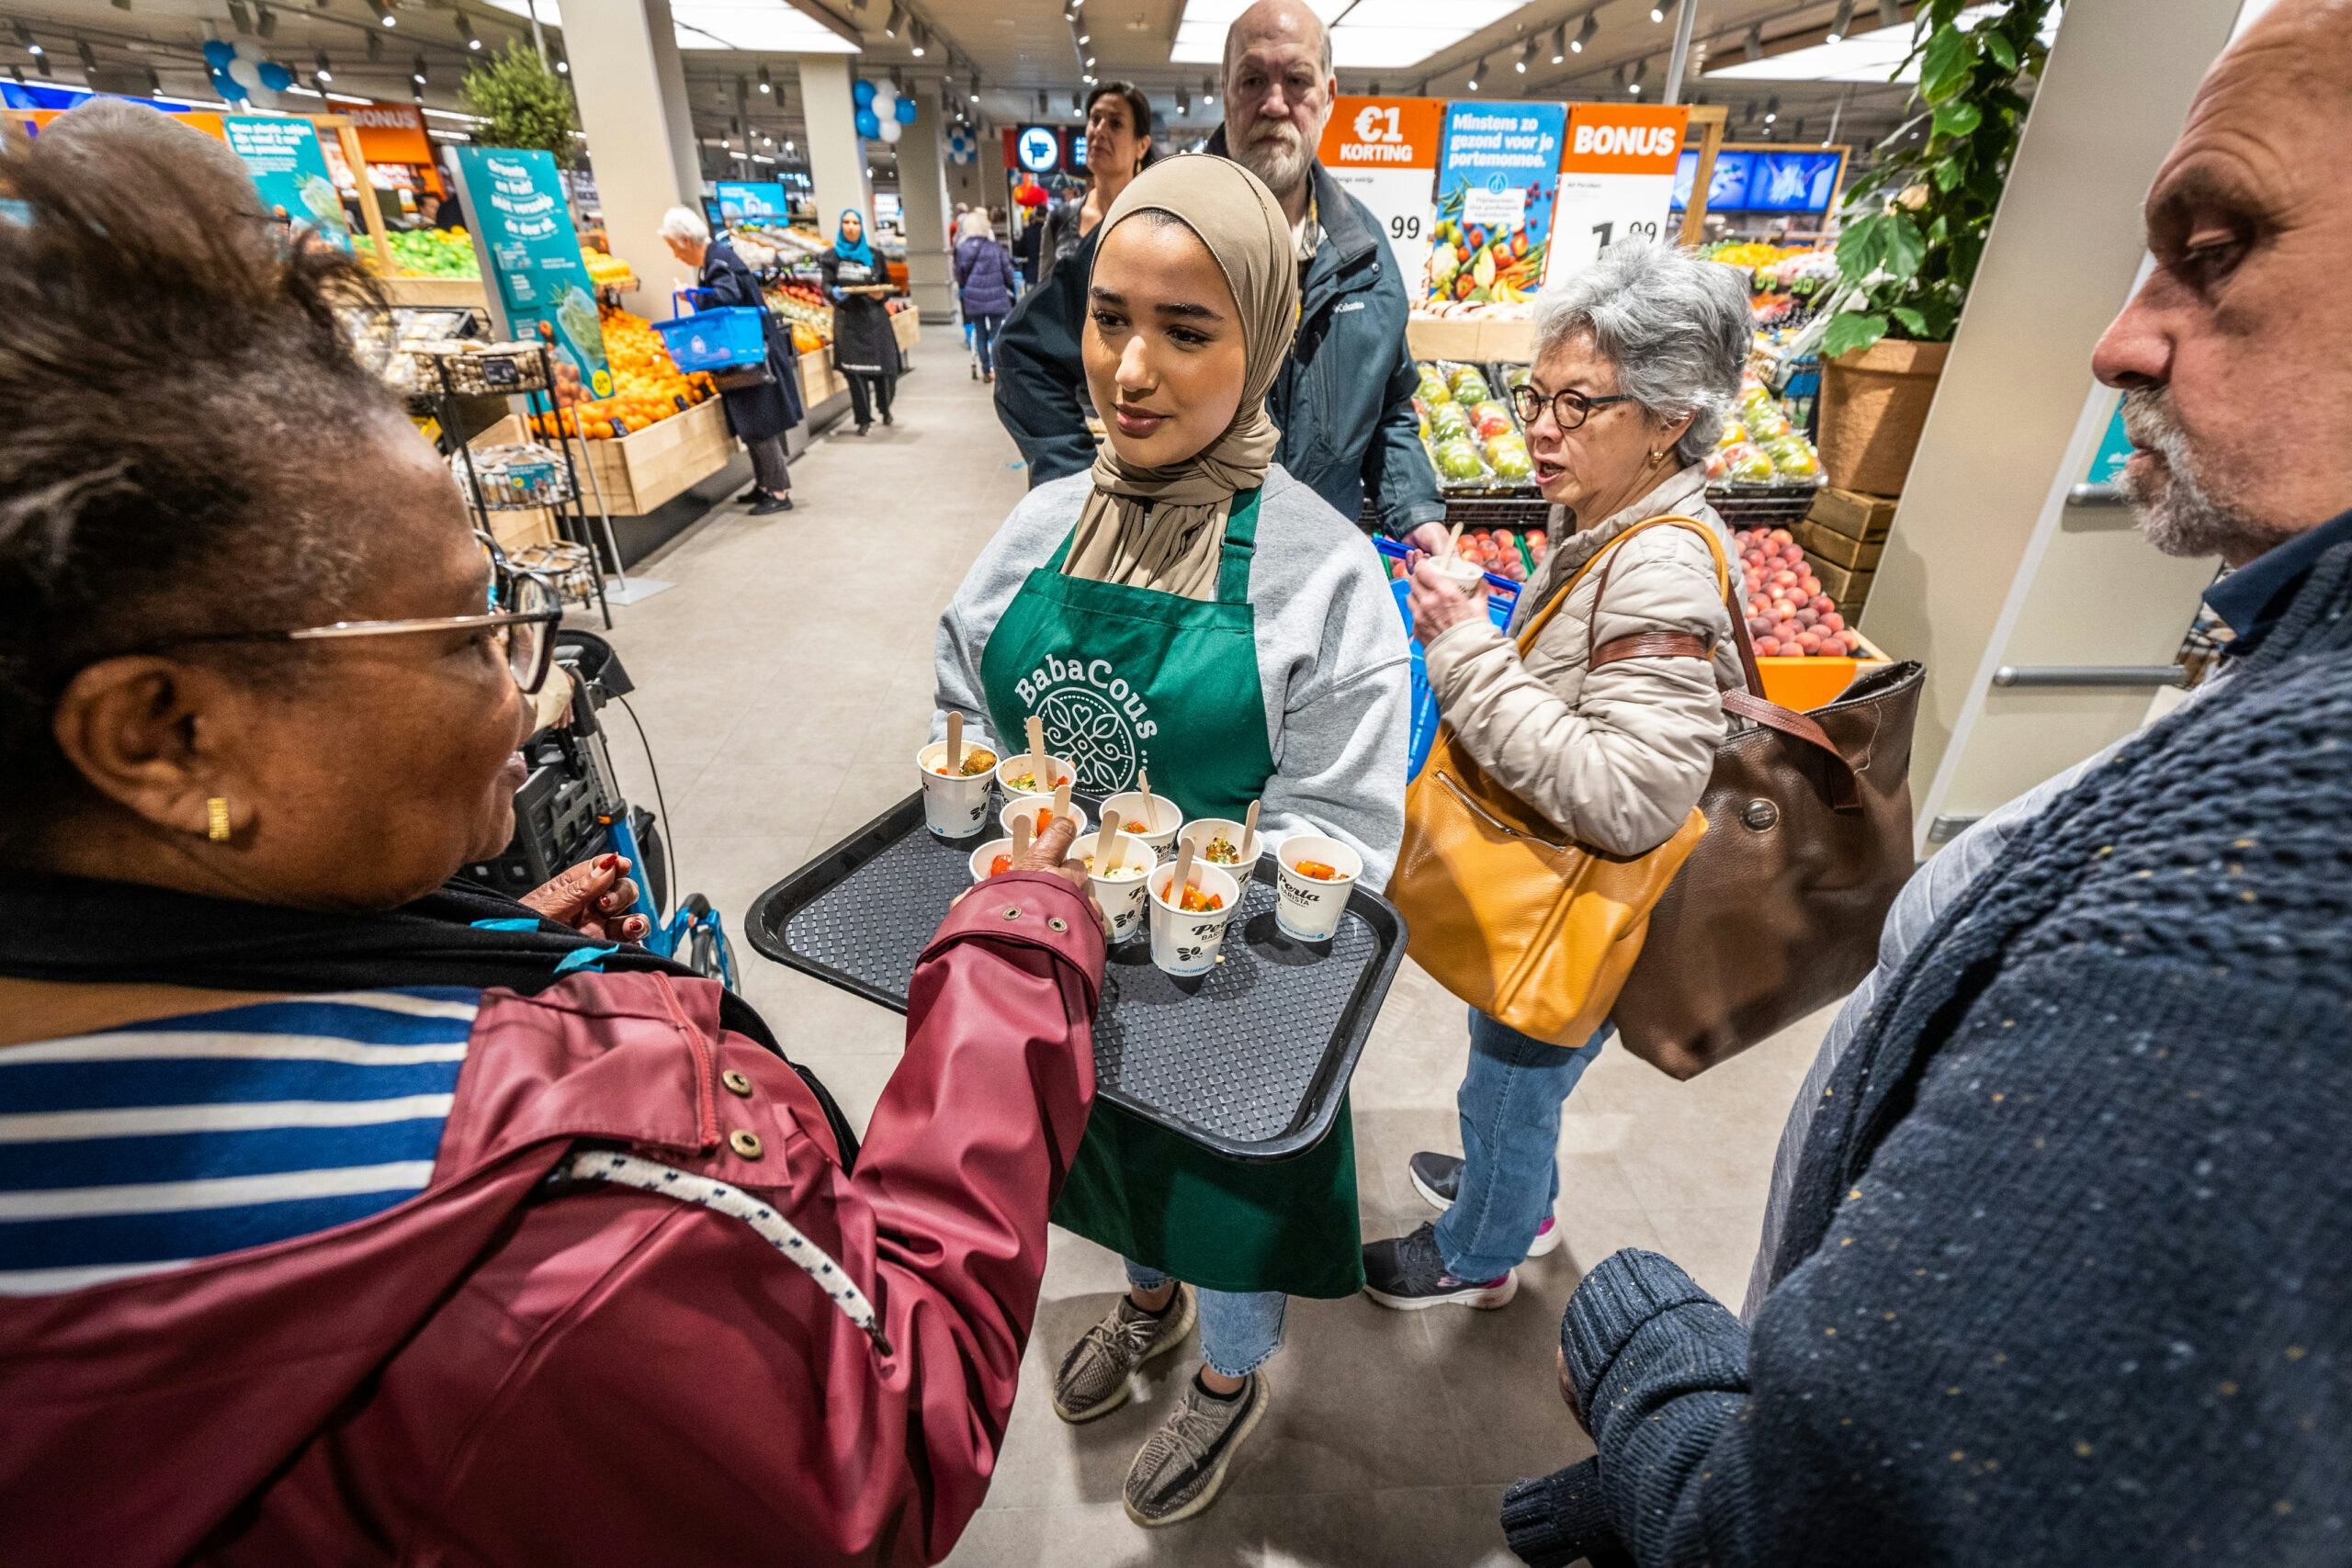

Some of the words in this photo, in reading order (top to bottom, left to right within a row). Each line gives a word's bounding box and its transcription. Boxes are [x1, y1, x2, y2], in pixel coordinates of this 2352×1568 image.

[350, 108, 416, 129] BONUS
[1353, 106, 1403, 142] €1
[1453, 113, 1518, 131] Minstens
[1520, 118, 1539, 131] zo
[1450, 131, 1502, 152] gezond
[1504, 135, 1538, 150] voor
[1537, 131, 1555, 153] je
[1573, 125, 1677, 157] BONUS
[1340, 143, 1413, 163] KORTING
[1448, 151, 1546, 170] portemonnee.
[1391, 216, 1420, 239] 99
[1014, 654, 1158, 739] BabaCous
[1278, 870, 1320, 902] Perla
